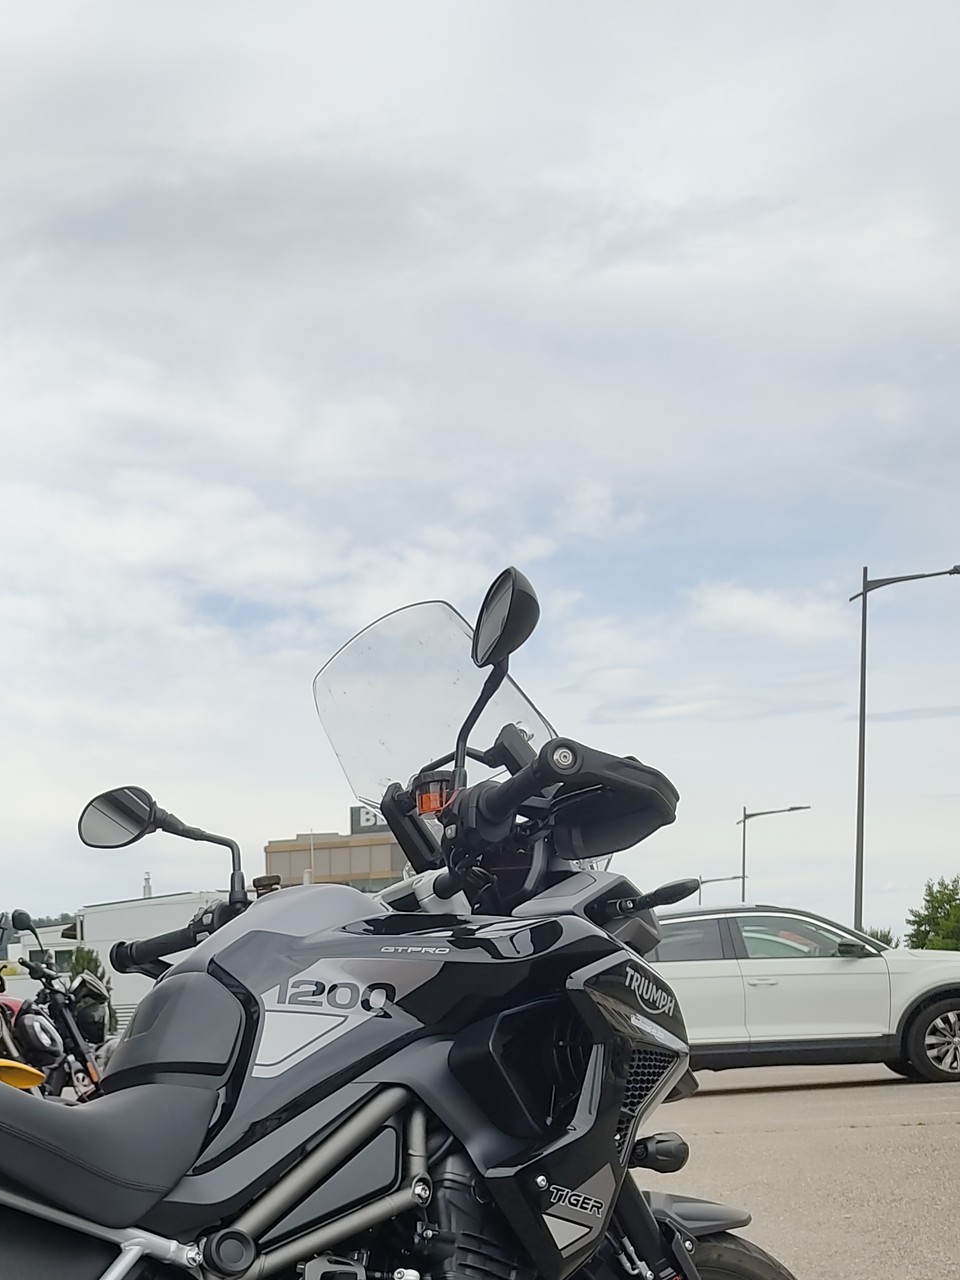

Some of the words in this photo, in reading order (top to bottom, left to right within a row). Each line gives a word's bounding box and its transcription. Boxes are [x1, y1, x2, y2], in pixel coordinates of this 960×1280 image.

[276, 978, 397, 1015] 1200
[625, 966, 676, 1017] TRIUMPH
[549, 1184, 605, 1218] TIGER
